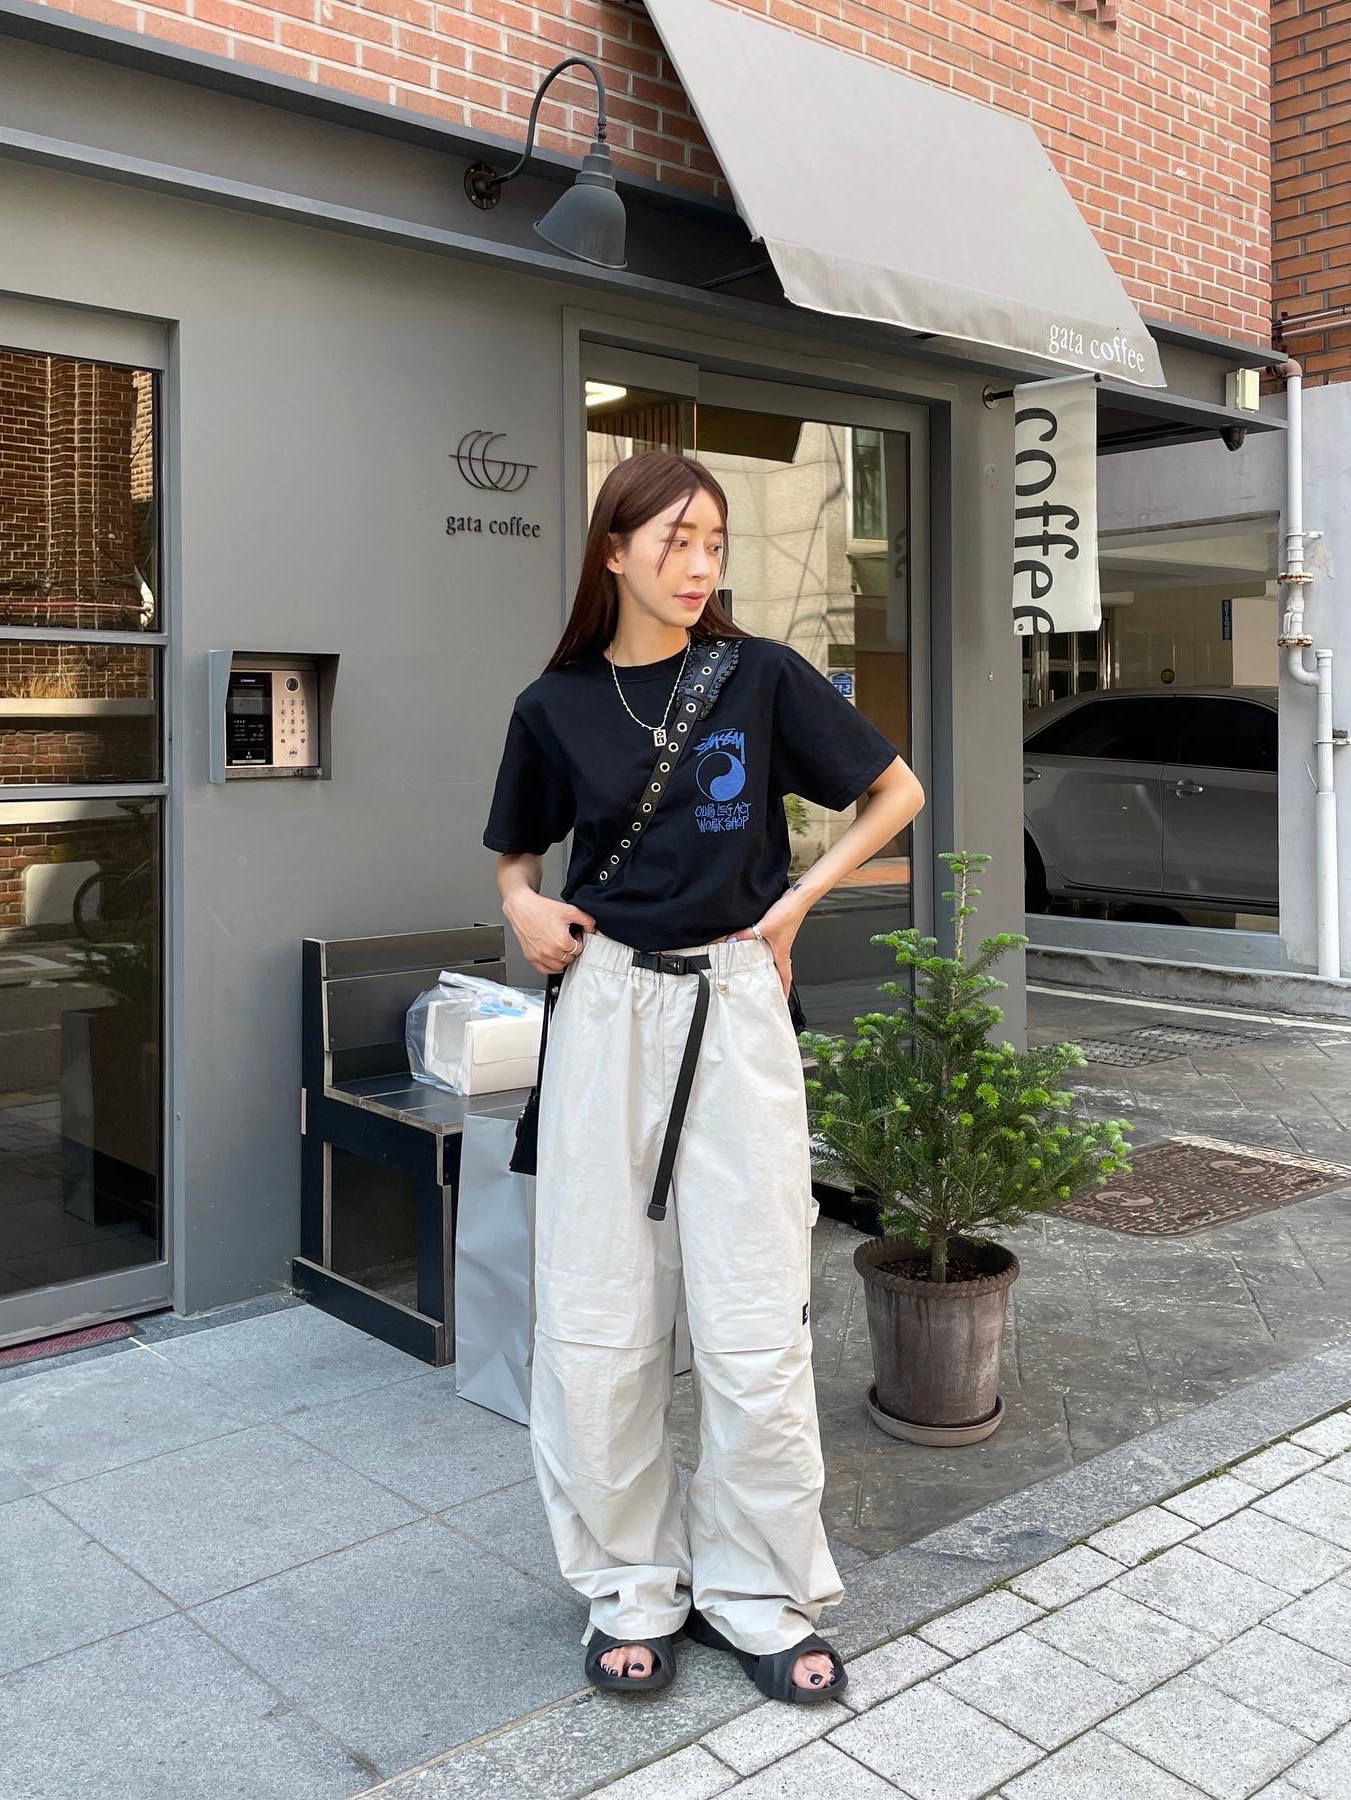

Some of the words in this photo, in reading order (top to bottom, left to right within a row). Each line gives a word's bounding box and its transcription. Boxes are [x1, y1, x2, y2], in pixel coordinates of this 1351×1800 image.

[1049, 324, 1084, 355] gata
[1090, 336, 1145, 372] coffee
[446, 516, 482, 536] gata
[489, 516, 541, 537] coffee
[717, 801, 752, 817] LEGACY
